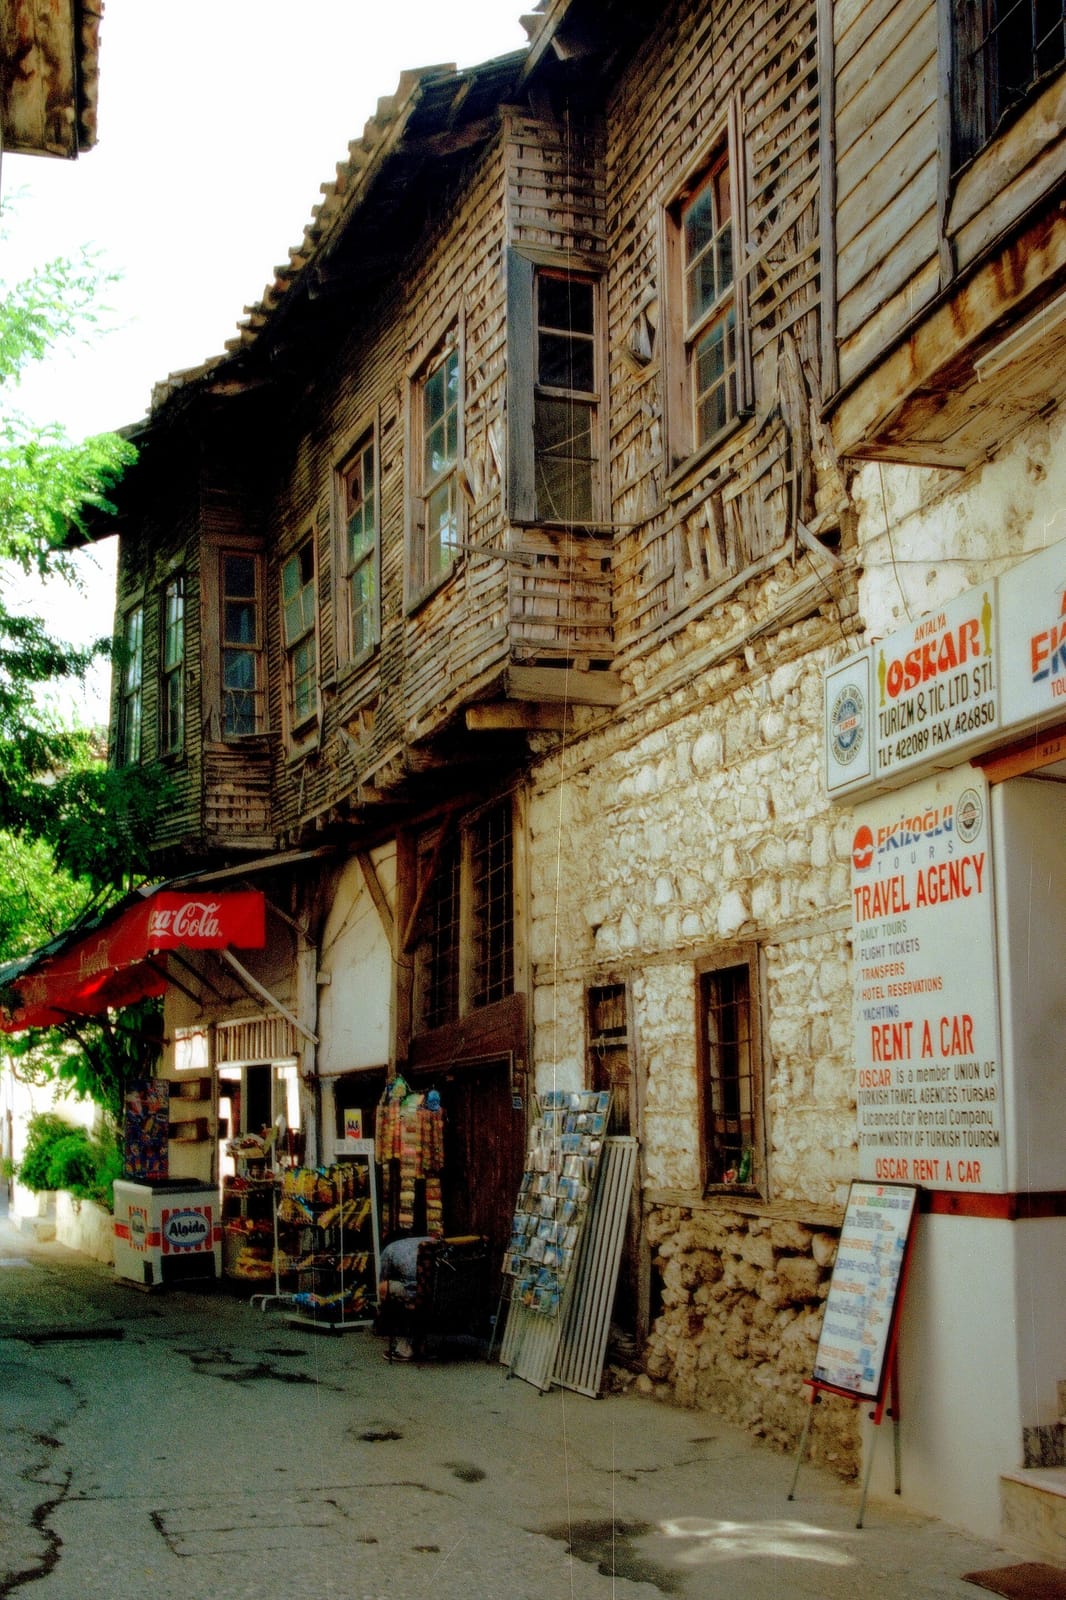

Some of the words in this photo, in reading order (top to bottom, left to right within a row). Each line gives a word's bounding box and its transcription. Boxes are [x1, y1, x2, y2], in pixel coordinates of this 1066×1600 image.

[914, 612, 947, 642] ANTALYA
[886, 617, 981, 699] OSKAR
[917, 692, 927, 722] &
[878, 745, 893, 768] TLF
[895, 728, 929, 760] 422089
[955, 700, 995, 734] 426850
[877, 840, 953, 873] TOURS
[854, 875, 911, 923] TRAVEL
[916, 852, 984, 908] AGENCY
[861, 926, 880, 941] DAILY
[882, 920, 907, 937] TOURS
[861, 945, 885, 961] FLIGHT
[888, 937, 920, 956] TICKETS
[862, 961, 905, 980] TRANSFERS
[862, 986, 885, 1001] HOTEL
[887, 976, 943, 997] RESERVATIONS
[863, 1004, 900, 1020] YACHTING
[871, 1021, 913, 1062] RENT
[921, 1019, 933, 1058] A
[940, 1014, 974, 1057] CAR
[859, 1068, 891, 1088] OSCAR
[896, 1066, 904, 1083] is
[908, 1069, 913, 1083] a
[916, 1064, 951, 1082] member
[954, 1063, 980, 1080] UNION
[984, 1061, 996, 1079] OF
[858, 1089, 889, 1105] TURKISH
[890, 1088, 917, 1104] TRAVEL
[920, 1086, 958, 1103] AGENCIES
[901, 1109, 916, 1126] Car
[918, 1109, 948, 1125] Rental
[950, 1108, 993, 1128] Company
[879, 1130, 912, 1147] MINISTRY
[915, 1130, 924, 1147] OF
[926, 1130, 960, 1147] TURKISH
[962, 1130, 1000, 1148] TOURISM
[875, 1158, 909, 1180] OSCAR
[912, 1159, 939, 1181] RENT
[945, 1160, 953, 1182] A
[957, 1160, 981, 1183] CAR
[169, 1220, 206, 1238] Algida
